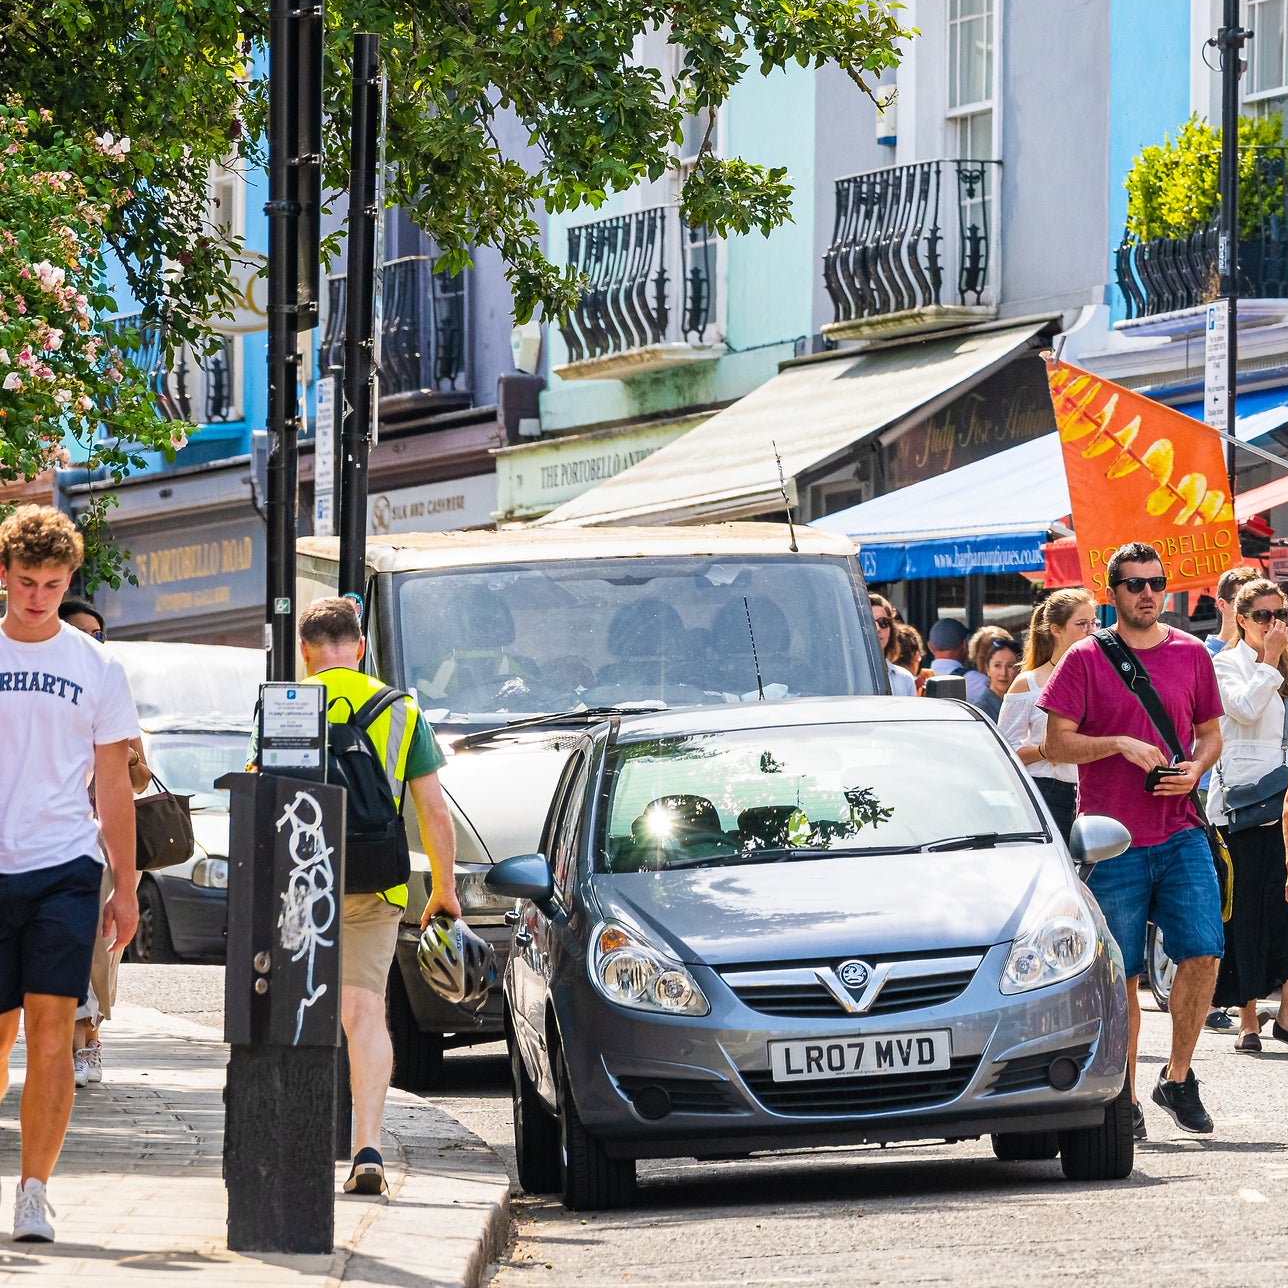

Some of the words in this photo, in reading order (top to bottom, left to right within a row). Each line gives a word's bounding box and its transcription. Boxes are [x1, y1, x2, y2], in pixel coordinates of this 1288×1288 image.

[541, 465, 559, 489] THE
[561, 454, 620, 487] PORTOBELLO
[391, 504, 407, 520] SILK
[150, 542, 219, 584] PORTOBELLO
[222, 536, 252, 572] ROAD
[1089, 530, 1231, 569] POOBELLO
[1180, 552, 1231, 577] CHIP
[784, 1042, 865, 1075] LR07
[875, 1037, 935, 1069] MVD
